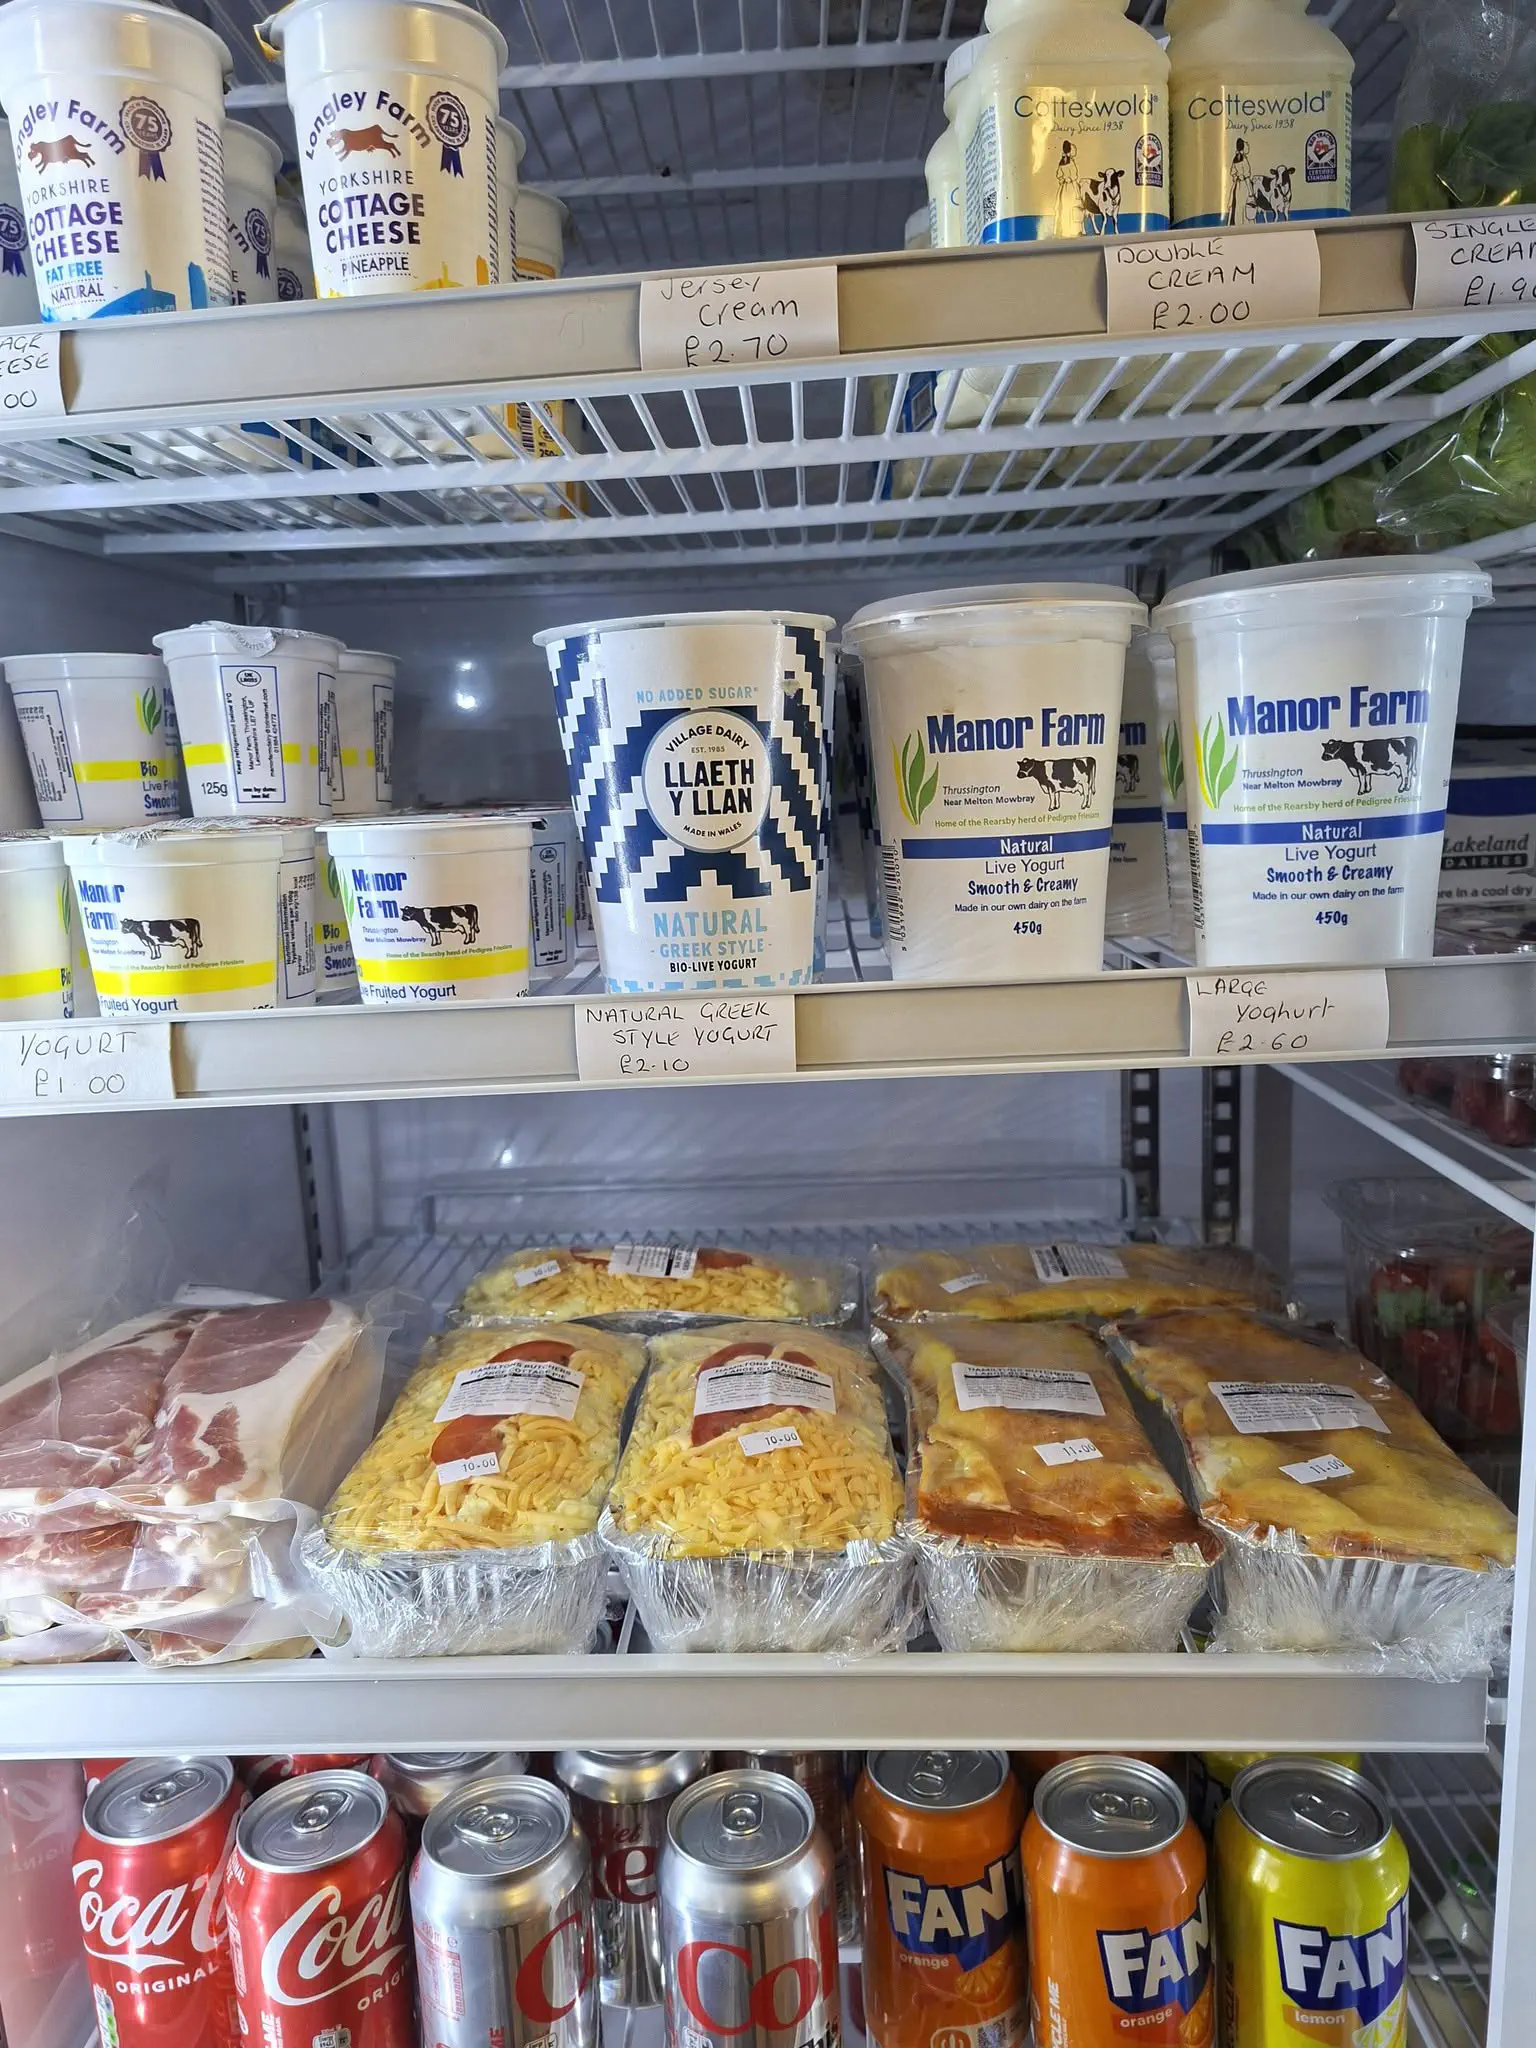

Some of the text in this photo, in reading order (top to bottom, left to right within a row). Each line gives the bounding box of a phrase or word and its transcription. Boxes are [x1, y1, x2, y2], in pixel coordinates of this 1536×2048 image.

[68, 99, 126, 155] Farm
[135, 113, 159, 132] 75
[305, 91, 367, 160] Longley
[376, 90, 432, 149] Farm
[440, 108, 460, 128] 75
[1051, 121, 1124, 134] Dairy Since 1938
[1225, 119, 1295, 134] Dairy Since 1938
[26, 178, 110, 205] YORKSHIRE
[319, 169, 414, 196] YORKSHIRE
[318, 192, 425, 229] COTTAGE
[29, 201, 123, 241] COTTAGE
[1423, 217, 1536, 240] SINGLE
[326, 221, 421, 255] CHEESE
[36, 230, 120, 267] CHEESE
[46, 260, 103, 284] FAT FREE
[341, 257, 409, 277] PINEAPPLE
[1148, 262, 1256, 290] CREAM
[51, 283, 104, 304] NATURAL
[1152, 300, 1251, 330] £2.00
[685, 334, 788, 367] £2.70
[636, 690, 654, 704] NO
[659, 688, 703, 702] ADDED
[1227, 686, 1430, 737] Manor Farm
[665, 725, 750, 753] VILLAGE DAIRY
[927, 714, 1034, 754] Manor
[1041, 707, 1105, 748] Farm
[708, 745, 726, 753] 1985
[140, 761, 158, 777] Bio
[664, 759, 754, 788] LLAETH
[1242, 766, 1303, 778] Thrussington
[143, 781, 162, 792] Live
[201, 782, 228, 797] 125g
[943, 784, 1001, 796] Thrussington
[1242, 777, 1342, 790] Near Melton Mowbray
[669, 787, 753, 816] Y LLAN
[944, 794, 1035, 806] Near Melton Mowbray
[683, 824, 706, 837] MADE
[717, 822, 742, 837] WALES
[935, 813, 1077, 828] Home of the Rearsby herd of Pedigree
[1302, 823, 1362, 842] Natural
[1444, 832, 1530, 853] Lakeland
[1000, 836, 1053, 855] Natural
[1285, 843, 1377, 863] Live Yogurt
[985, 857, 1065, 876] Live Yogurt
[1267, 864, 1393, 884] Smooth & Creamy
[968, 877, 1079, 896] Smooth & Creamy
[1253, 886, 1405, 900] Made in our own dairy on the farm
[1456, 888, 1467, 897] in
[1471, 889, 1479, 897] a
[1482, 885, 1509, 897] cool
[1511, 885, 1532, 897] dry
[357, 896, 400, 919] Farm
[955, 897, 1087, 913] Made in our own dairy on the farm
[84, 907, 117, 931] Farm
[653, 908, 768, 938] NATURAL
[1013, 921, 1043, 936] 450g
[1315, 911, 1348, 926] 450g
[322, 924, 340, 939] Bio
[324, 943, 344, 954] Live
[659, 937, 765, 958] GREEK STYLE
[669, 958, 758, 973] BIO-LIVE YOGURT
[370, 984, 456, 1001] Fruited Yogurt
[1196, 978, 1267, 996] LARGE
[132, 998, 179, 1014] Yogurt
[586, 1001, 770, 1024] NATURAL GREEK
[613, 1023, 778, 1048] STYLE YOGURT
[1217, 1031, 1308, 1053] £2.60
[21, 1031, 137, 1066] YOGURT
[620, 1054, 690, 1074] £2.10
[886, 1858, 1010, 1943] FAN
[1278, 1898, 1405, 1999] FAN
[900, 1953, 949, 1970] orange
[115, 1962, 220, 1996] ORIGINAL
[1120, 2007, 1173, 2030] orange
[1294, 2010, 1346, 2025] lemon
